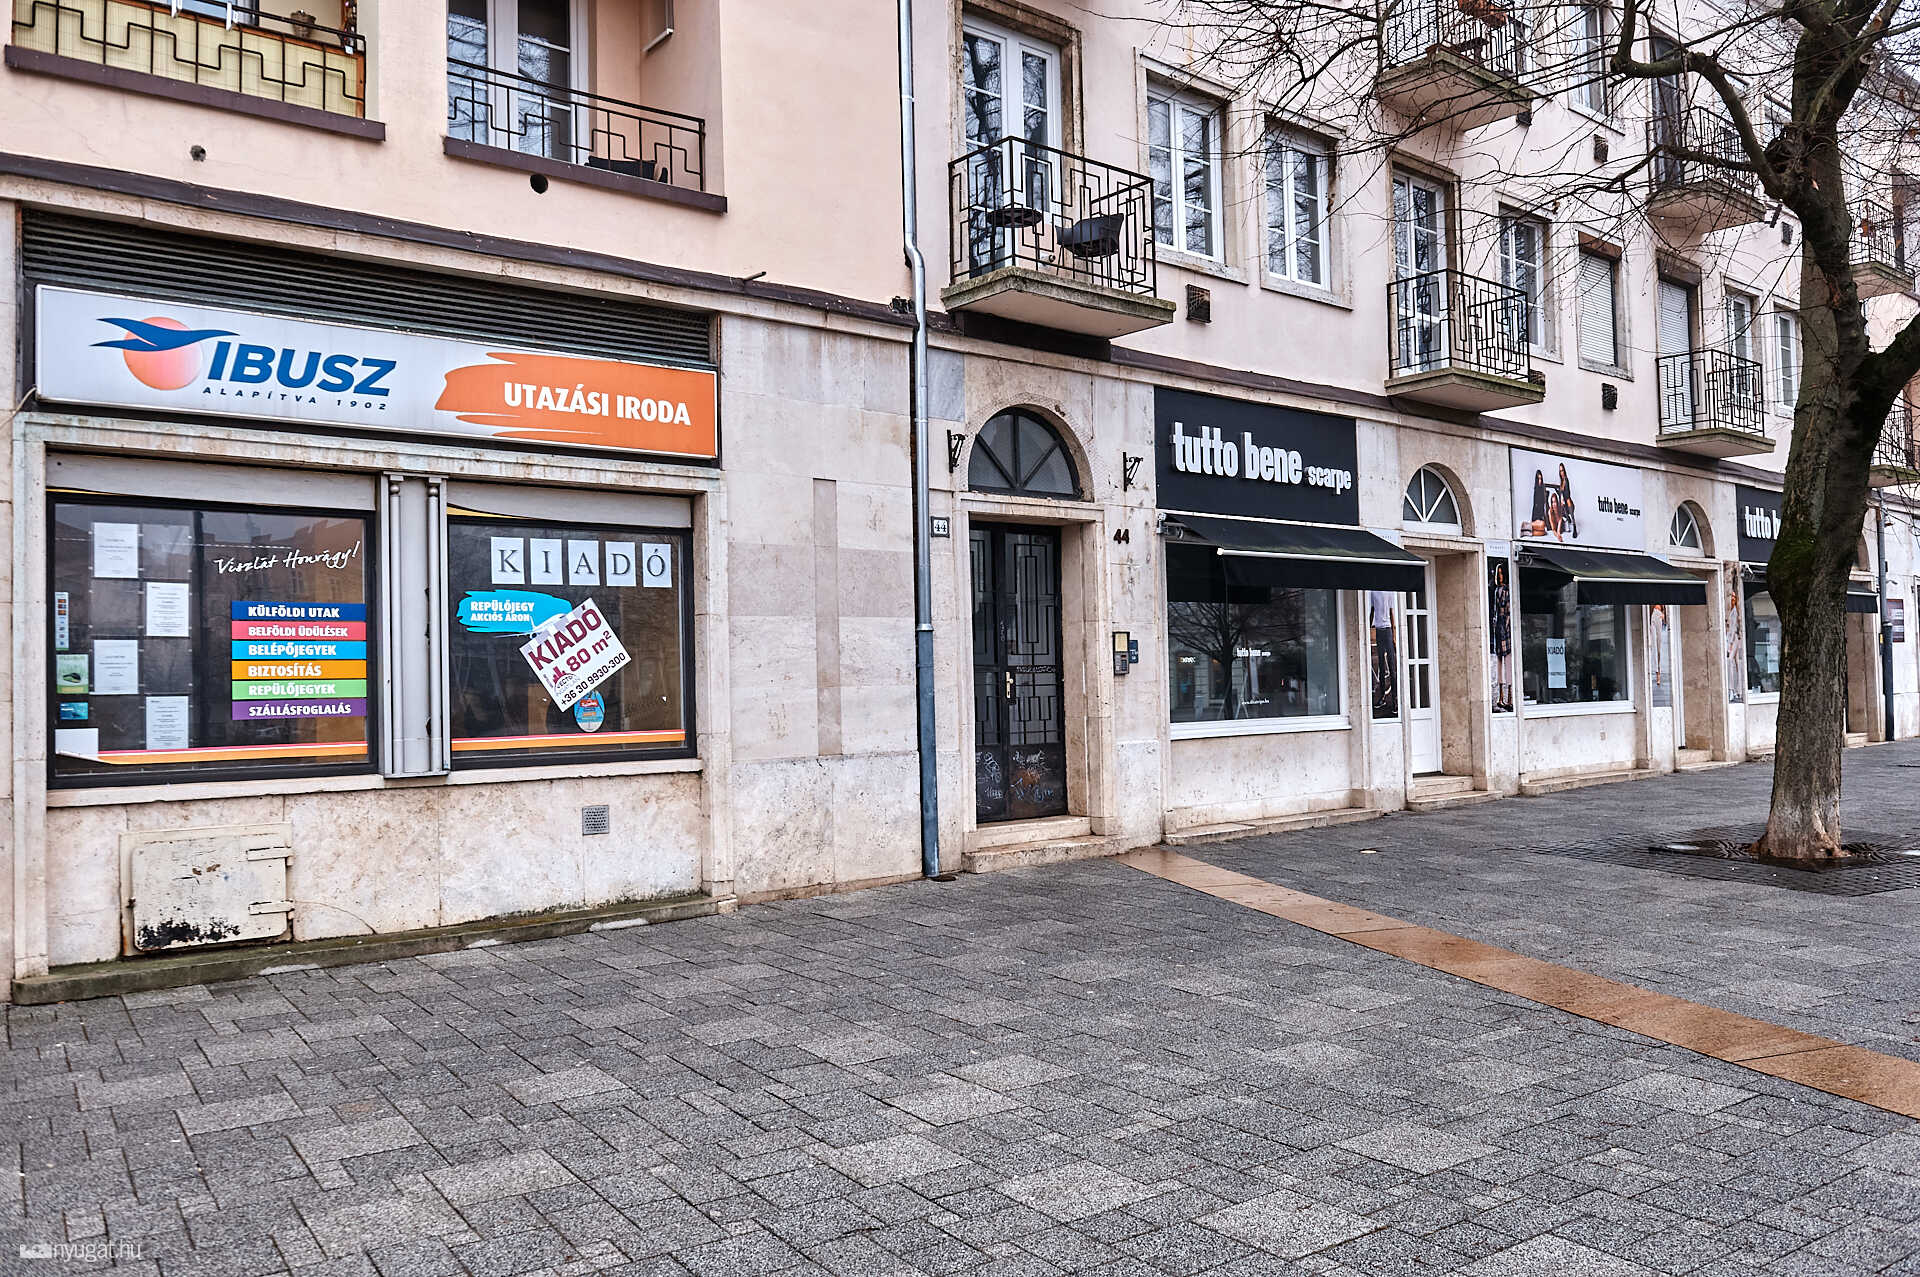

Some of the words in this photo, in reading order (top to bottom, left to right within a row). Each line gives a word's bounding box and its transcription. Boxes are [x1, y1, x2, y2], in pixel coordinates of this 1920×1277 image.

[208, 341, 397, 397] IBUSZ
[203, 386, 316, 404] ALAPÍTVA
[337, 399, 386, 411] 1902
[504, 382, 609, 417] UTAZÁSI
[616, 394, 692, 426] IRODA
[1171, 421, 1239, 478] tutto
[1243, 431, 1303, 485] bene
[1306, 465, 1352, 495] scarpe
[934, 520, 947, 533] 44
[1744, 505, 1771, 539] tutto
[1113, 528, 1130, 545] 44
[214, 555, 278, 574] Viszlát
[283, 540, 361, 569] Honvágy!
[248, 605, 305, 618] KÜLFÖLDI
[308, 607, 340, 618] UTAK
[470, 599, 535, 614] REPÜLŐJEGY
[470, 612, 503, 623] AKCIÓS
[505, 612, 530, 623] ÁRON
[248, 625, 296, 637] BELFÖLDI
[298, 625, 348, 637] ÜDÜLÉSEK
[528, 604, 602, 671] KIADÓ
[248, 642, 337, 658] BELÉPŐJEGYEK
[566, 648, 591, 672] 80
[248, 663, 322, 677] BIZTOSÍTÁS
[249, 682, 336, 697] REPÜLŐJEGYEK
[561, 689, 577, 706] +36
[575, 680, 589, 692] 30
[249, 703, 352, 717] SZÁLLÁSFOGLALÁS
